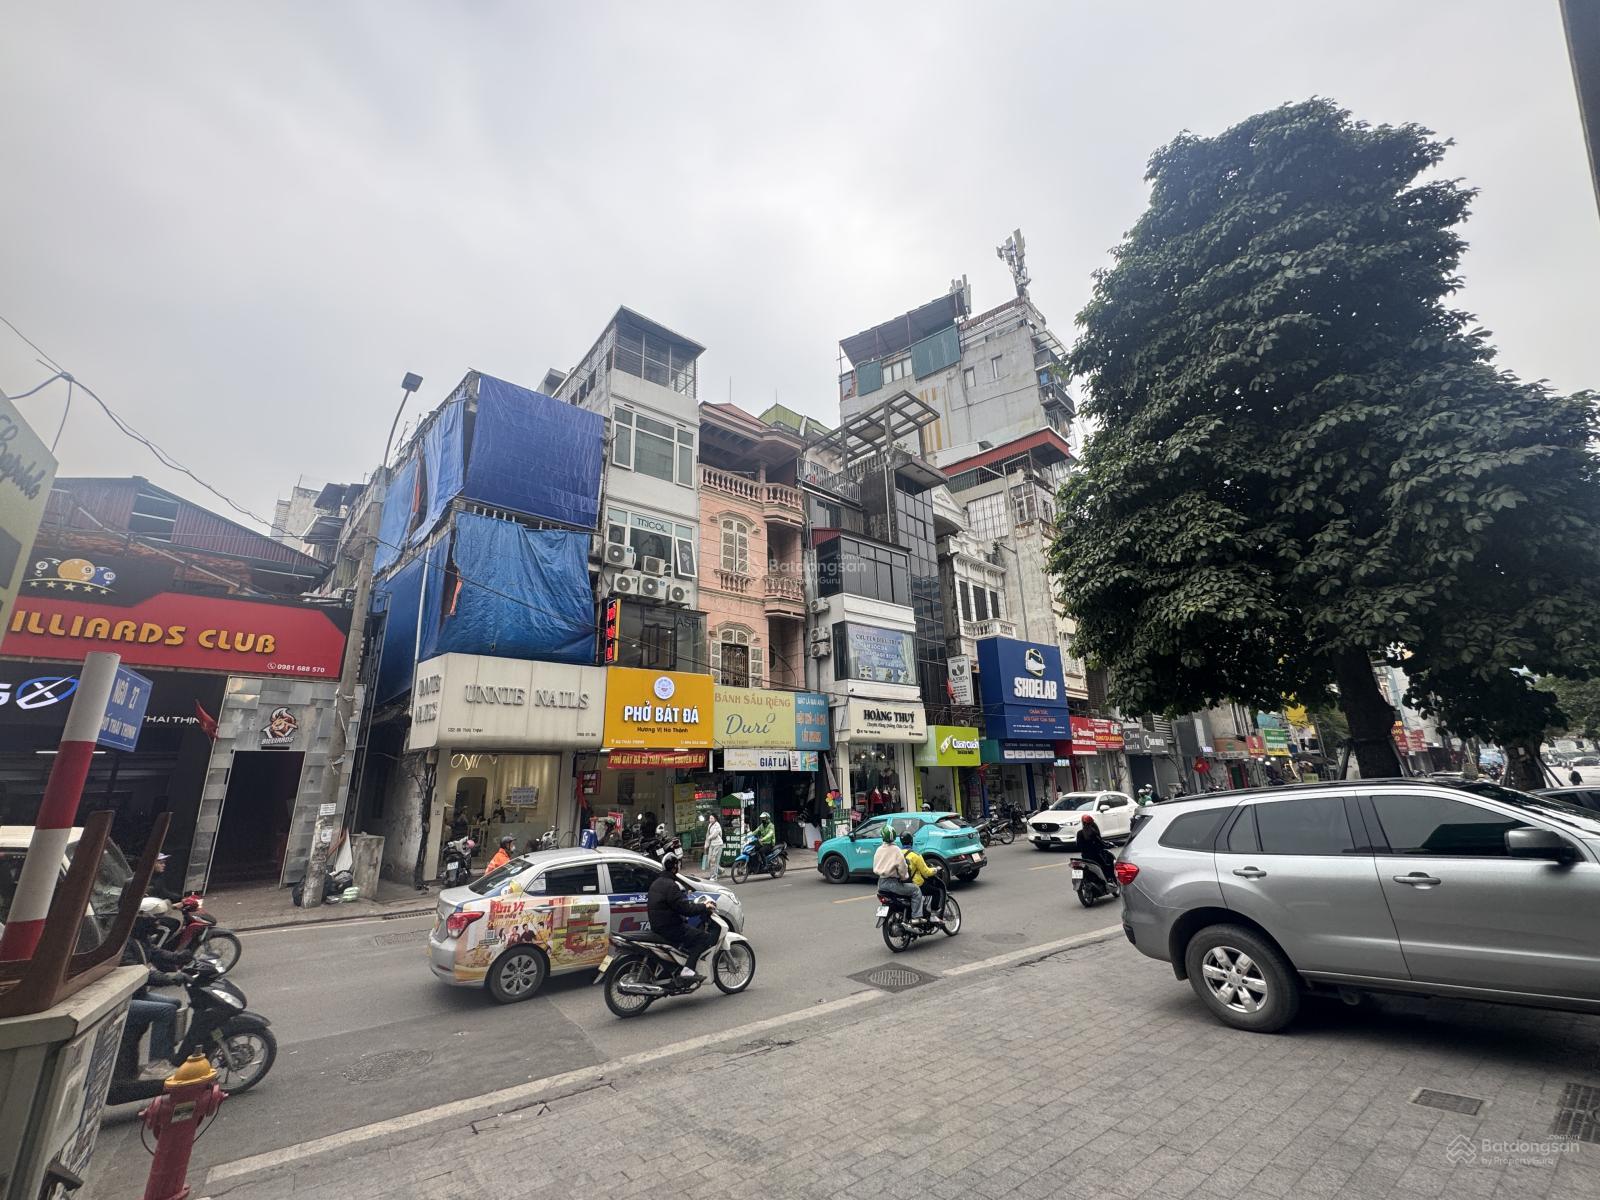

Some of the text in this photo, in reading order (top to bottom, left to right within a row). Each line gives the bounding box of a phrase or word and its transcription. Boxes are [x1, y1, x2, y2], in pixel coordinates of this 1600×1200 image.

[11, 610, 276, 653] ILLIARDS CLUB
[465, 684, 590, 710] UNNIE NAILS
[1014, 677, 1057, 700] SHOELAB
[714, 692, 741, 703] BÁNH
[765, 696, 791, 709] RIÊNG
[172, 716, 200, 725] THỊN
[624, 700, 699, 723] PHỞ BÁT ĐÁ
[863, 708, 892, 721] HOÀNG
[637, 726, 655, 734] Hương
[726, 713, 776, 735] Duri
[760, 756, 776, 768] GIẶT
[778, 755, 787, 767] LÀ
